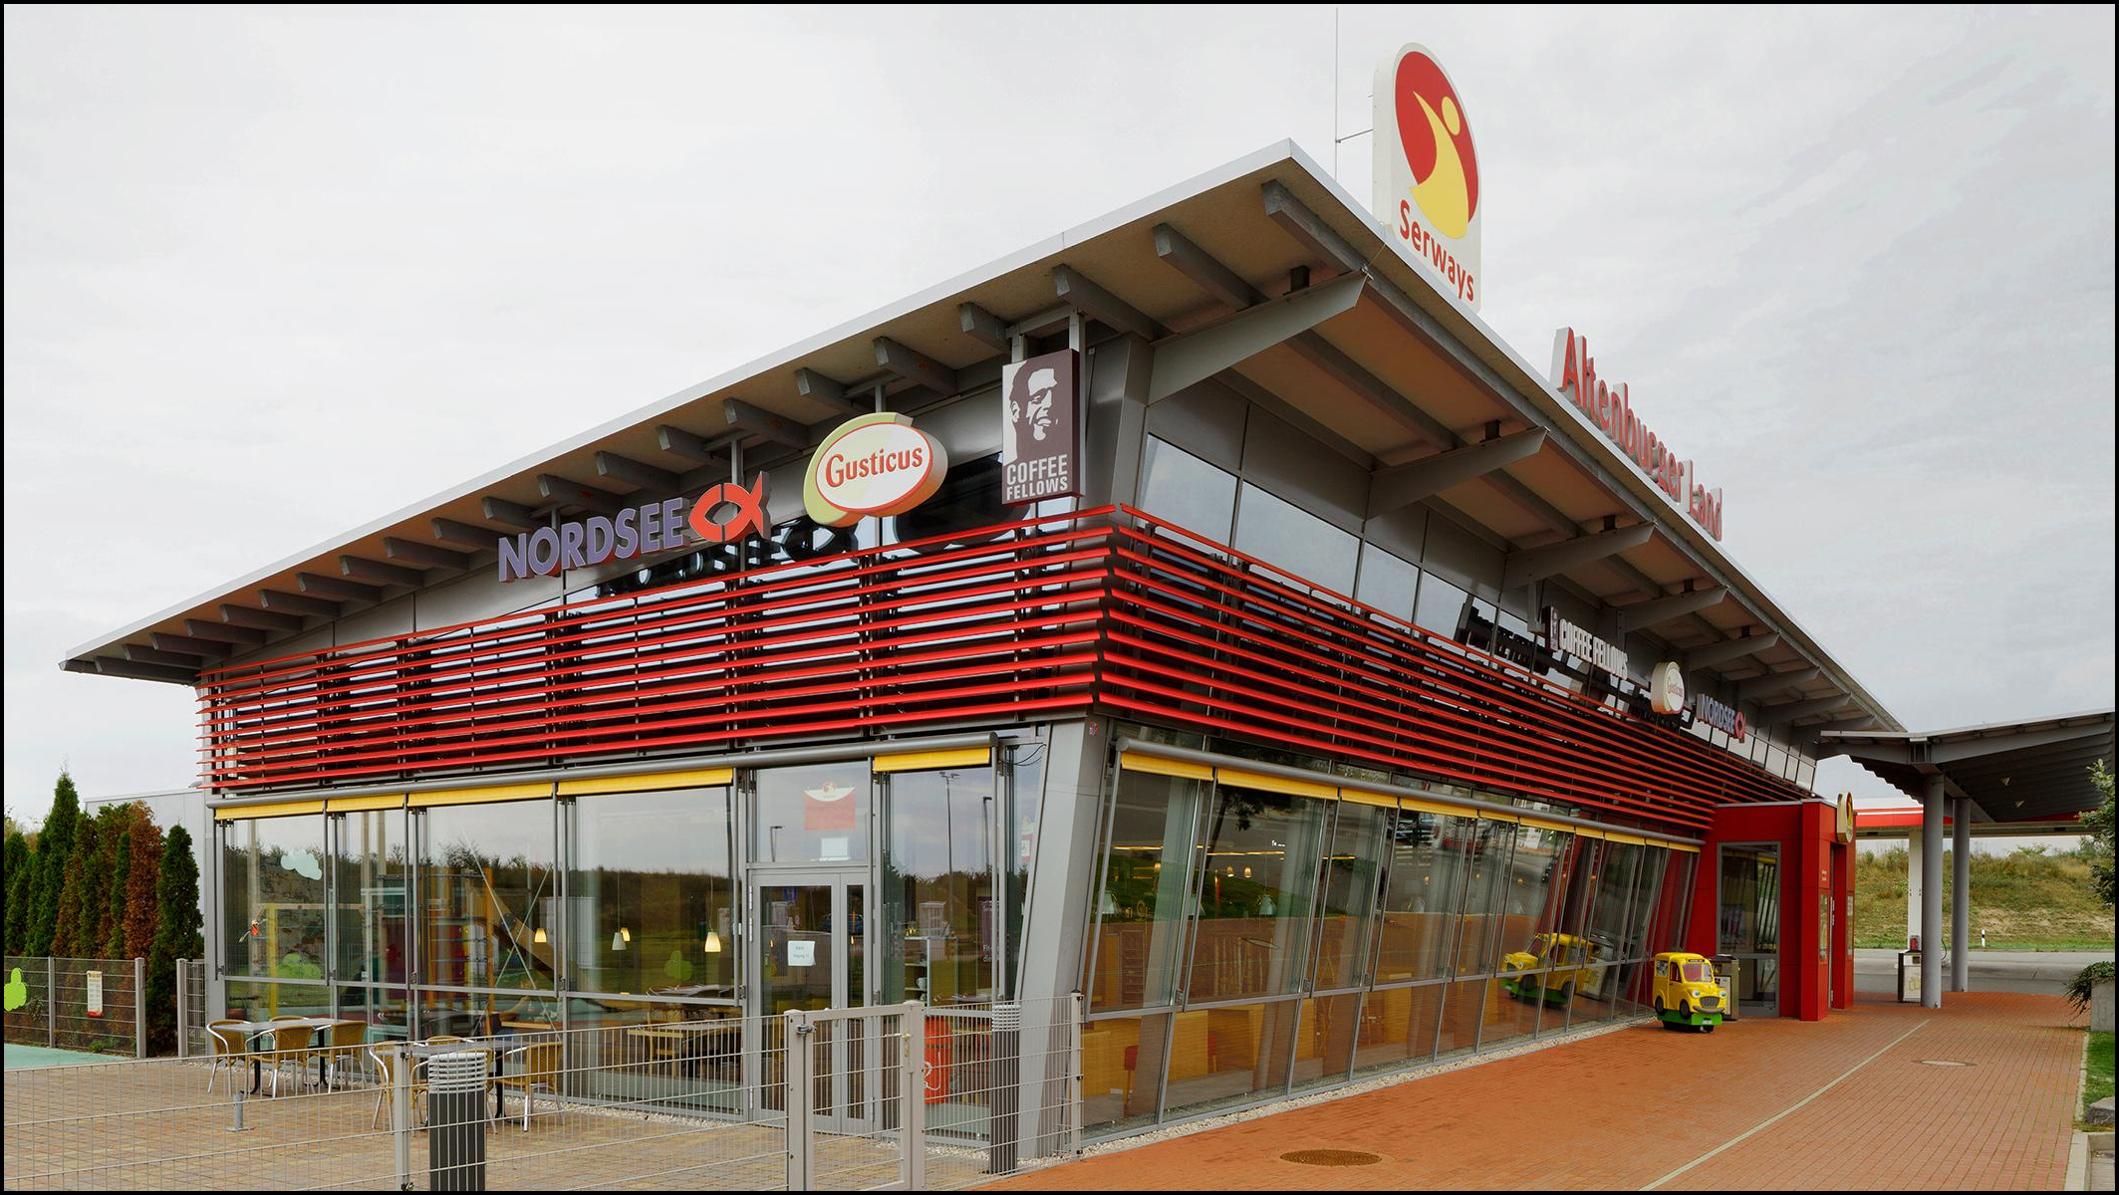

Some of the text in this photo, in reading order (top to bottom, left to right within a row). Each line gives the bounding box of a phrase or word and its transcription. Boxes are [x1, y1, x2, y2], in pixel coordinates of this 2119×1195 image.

[1400, 199, 1474, 302] Serways
[1555, 326, 1722, 542] Altenburger Land
[825, 447, 923, 488] Gusticus
[1006, 453, 1068, 486] COFFEE
[1006, 475, 1068, 501] FELLOWS
[498, 497, 685, 582] NORDSEE
[1559, 618, 1628, 680] COFFEE FELLOWS
